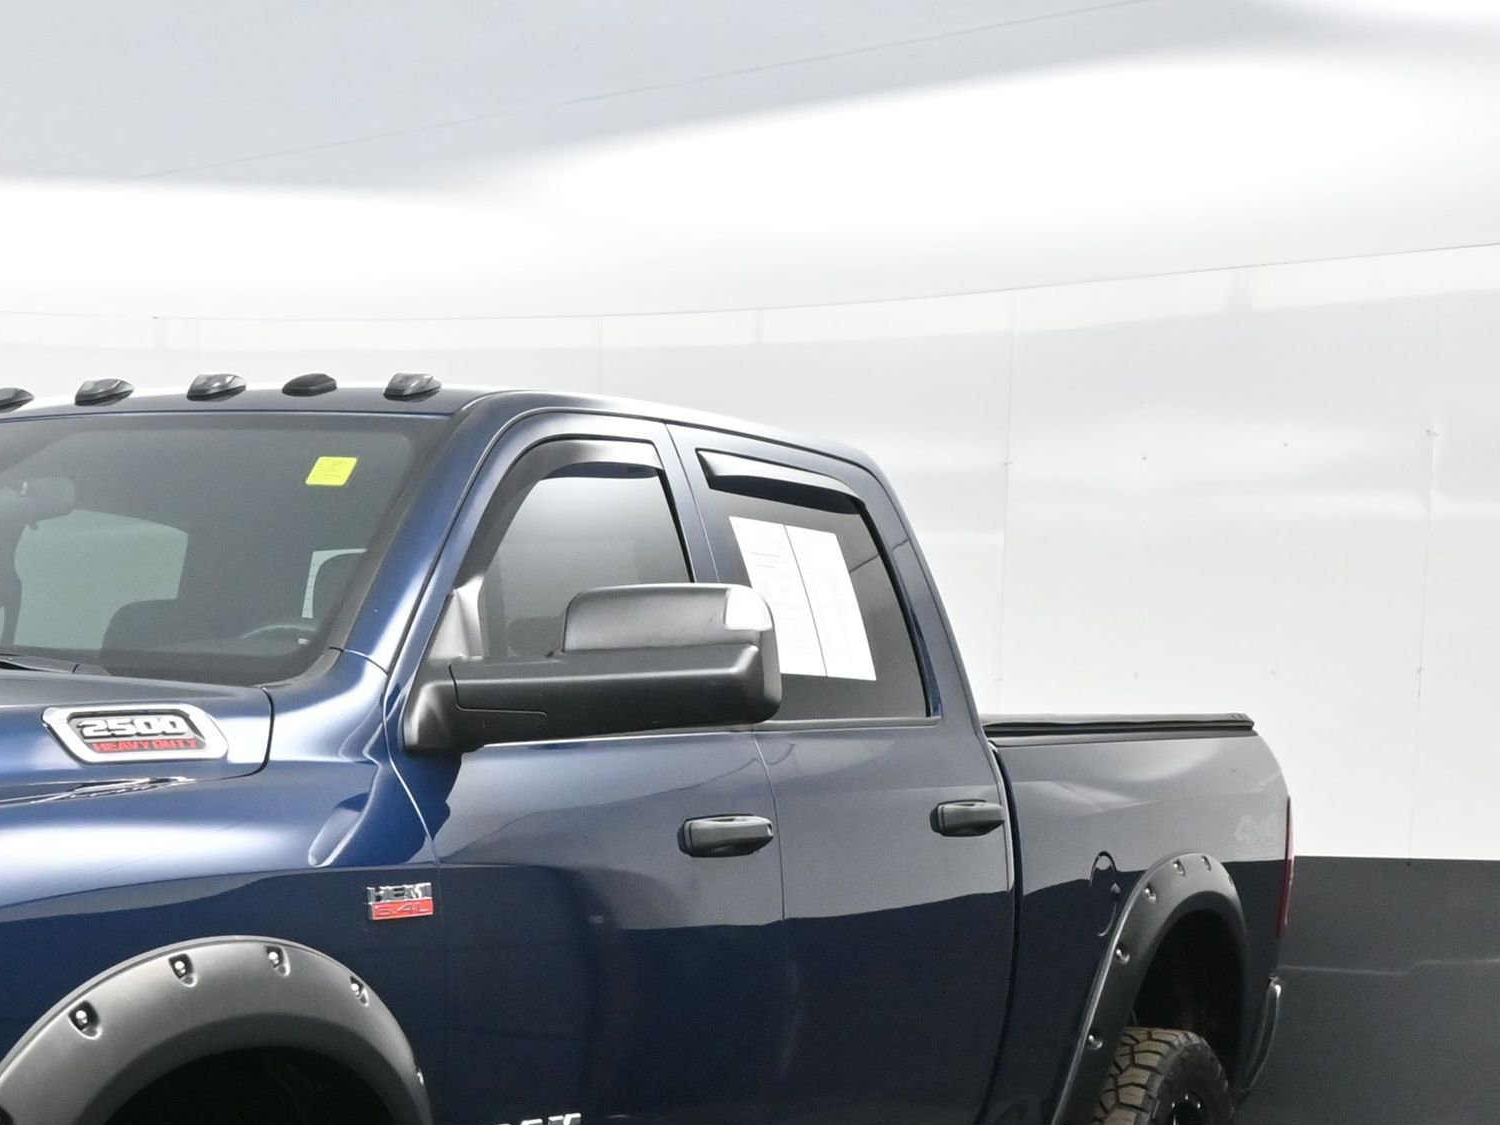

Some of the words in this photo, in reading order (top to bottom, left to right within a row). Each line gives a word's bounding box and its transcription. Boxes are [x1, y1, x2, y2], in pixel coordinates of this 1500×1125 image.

[77, 716, 189, 739] 2500
[93, 739, 150, 753] HEAVY
[154, 738, 197, 750] DUTY
